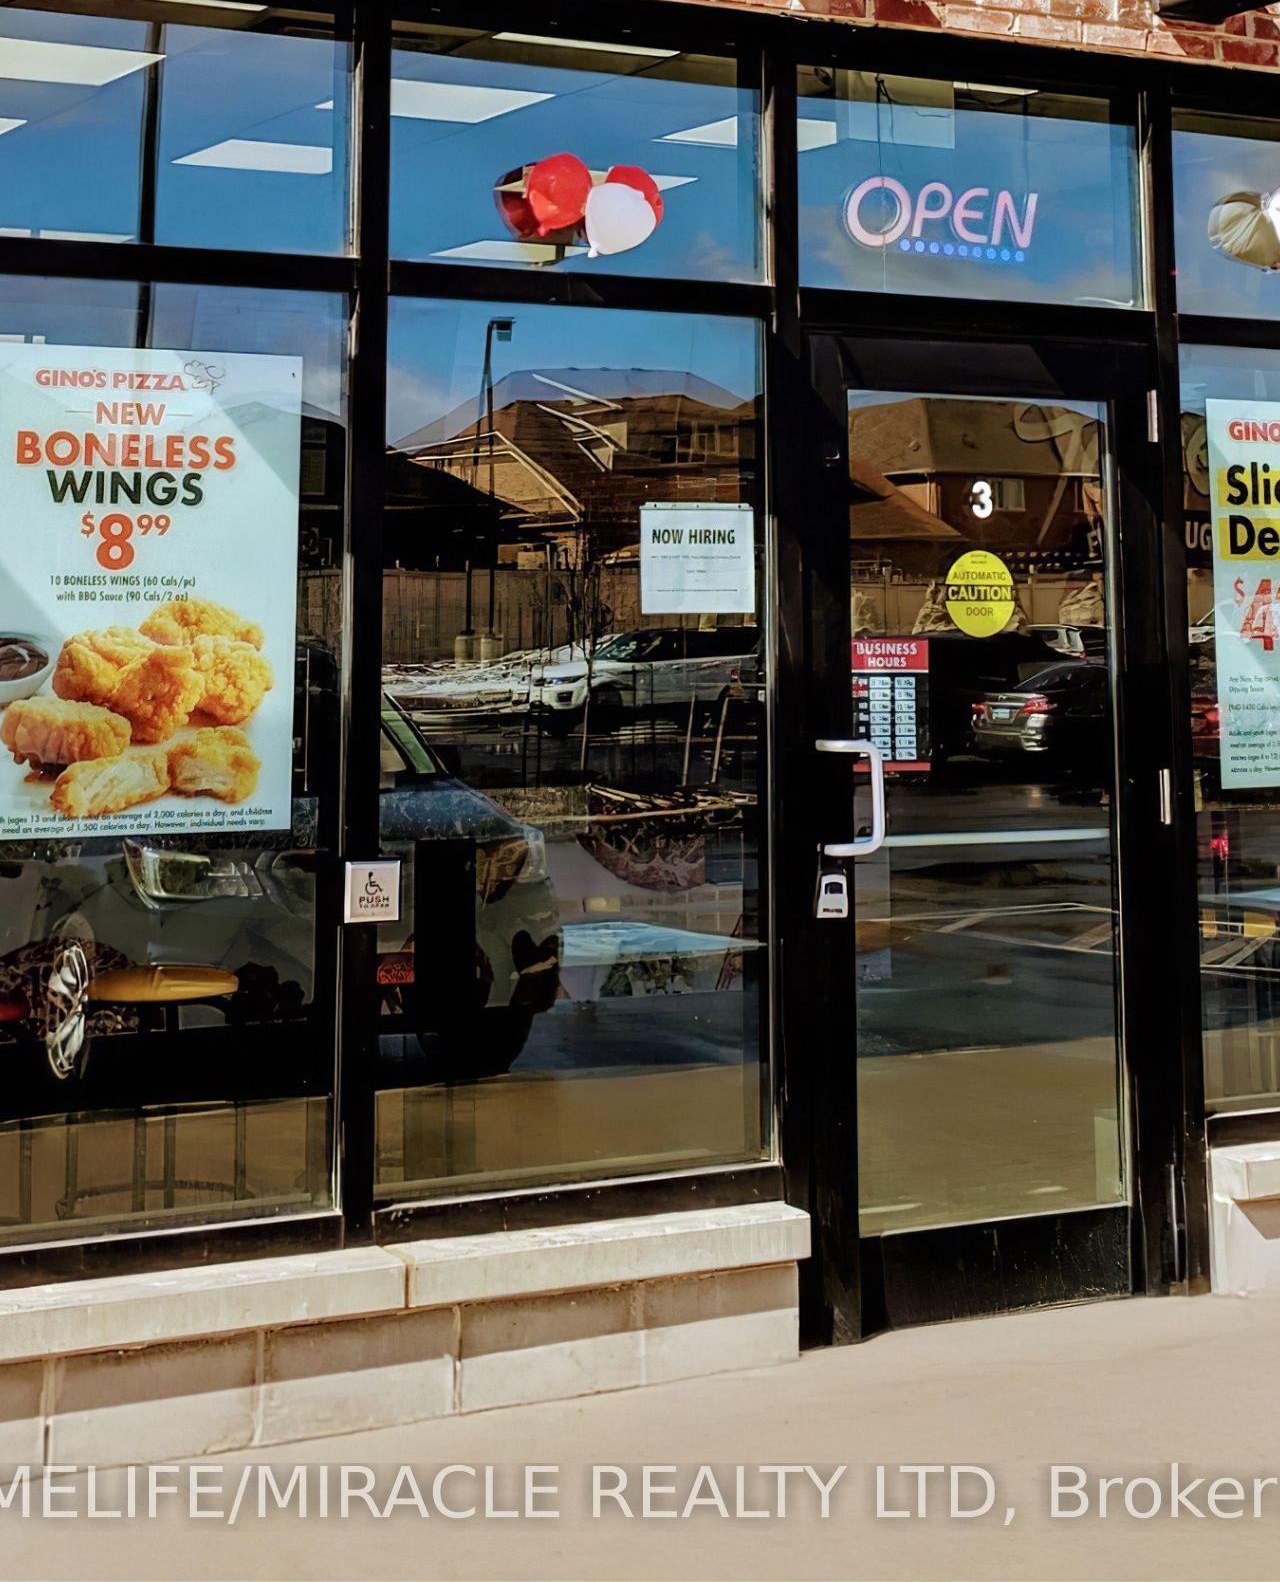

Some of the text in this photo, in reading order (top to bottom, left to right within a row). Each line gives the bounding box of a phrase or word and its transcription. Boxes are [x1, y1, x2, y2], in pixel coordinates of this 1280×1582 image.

[843, 176, 1038, 249] OPEN
[35, 369, 186, 391] GINO'S PIZZA
[95, 402, 166, 426] NEW
[16, 430, 236, 470] BONELESS
[47, 470, 204, 506] WINGS
[971, 481, 993, 518] 3
[652, 529, 735, 544] NOW HIRING
[50, 575, 61, 586] 10
[64, 575, 107, 586] BONELESS
[110, 575, 140, 586] WINGS
[143, 575, 158, 587] (60
[952, 571, 1006, 581] AUTOMATIC
[56, 591, 76, 601] with
[78, 591, 97, 602] BBQ
[99, 591, 123, 602] Sauce
[126, 591, 140, 602] (90
[948, 586, 1012, 600] CAUTION
[966, 606, 994, 616] DOOR
[856, 642, 918, 655] BUSINESS
[867, 657, 907, 667] HOURS
[31, 815, 39, 823] 13
[359, 896, 389, 904] PUSH
